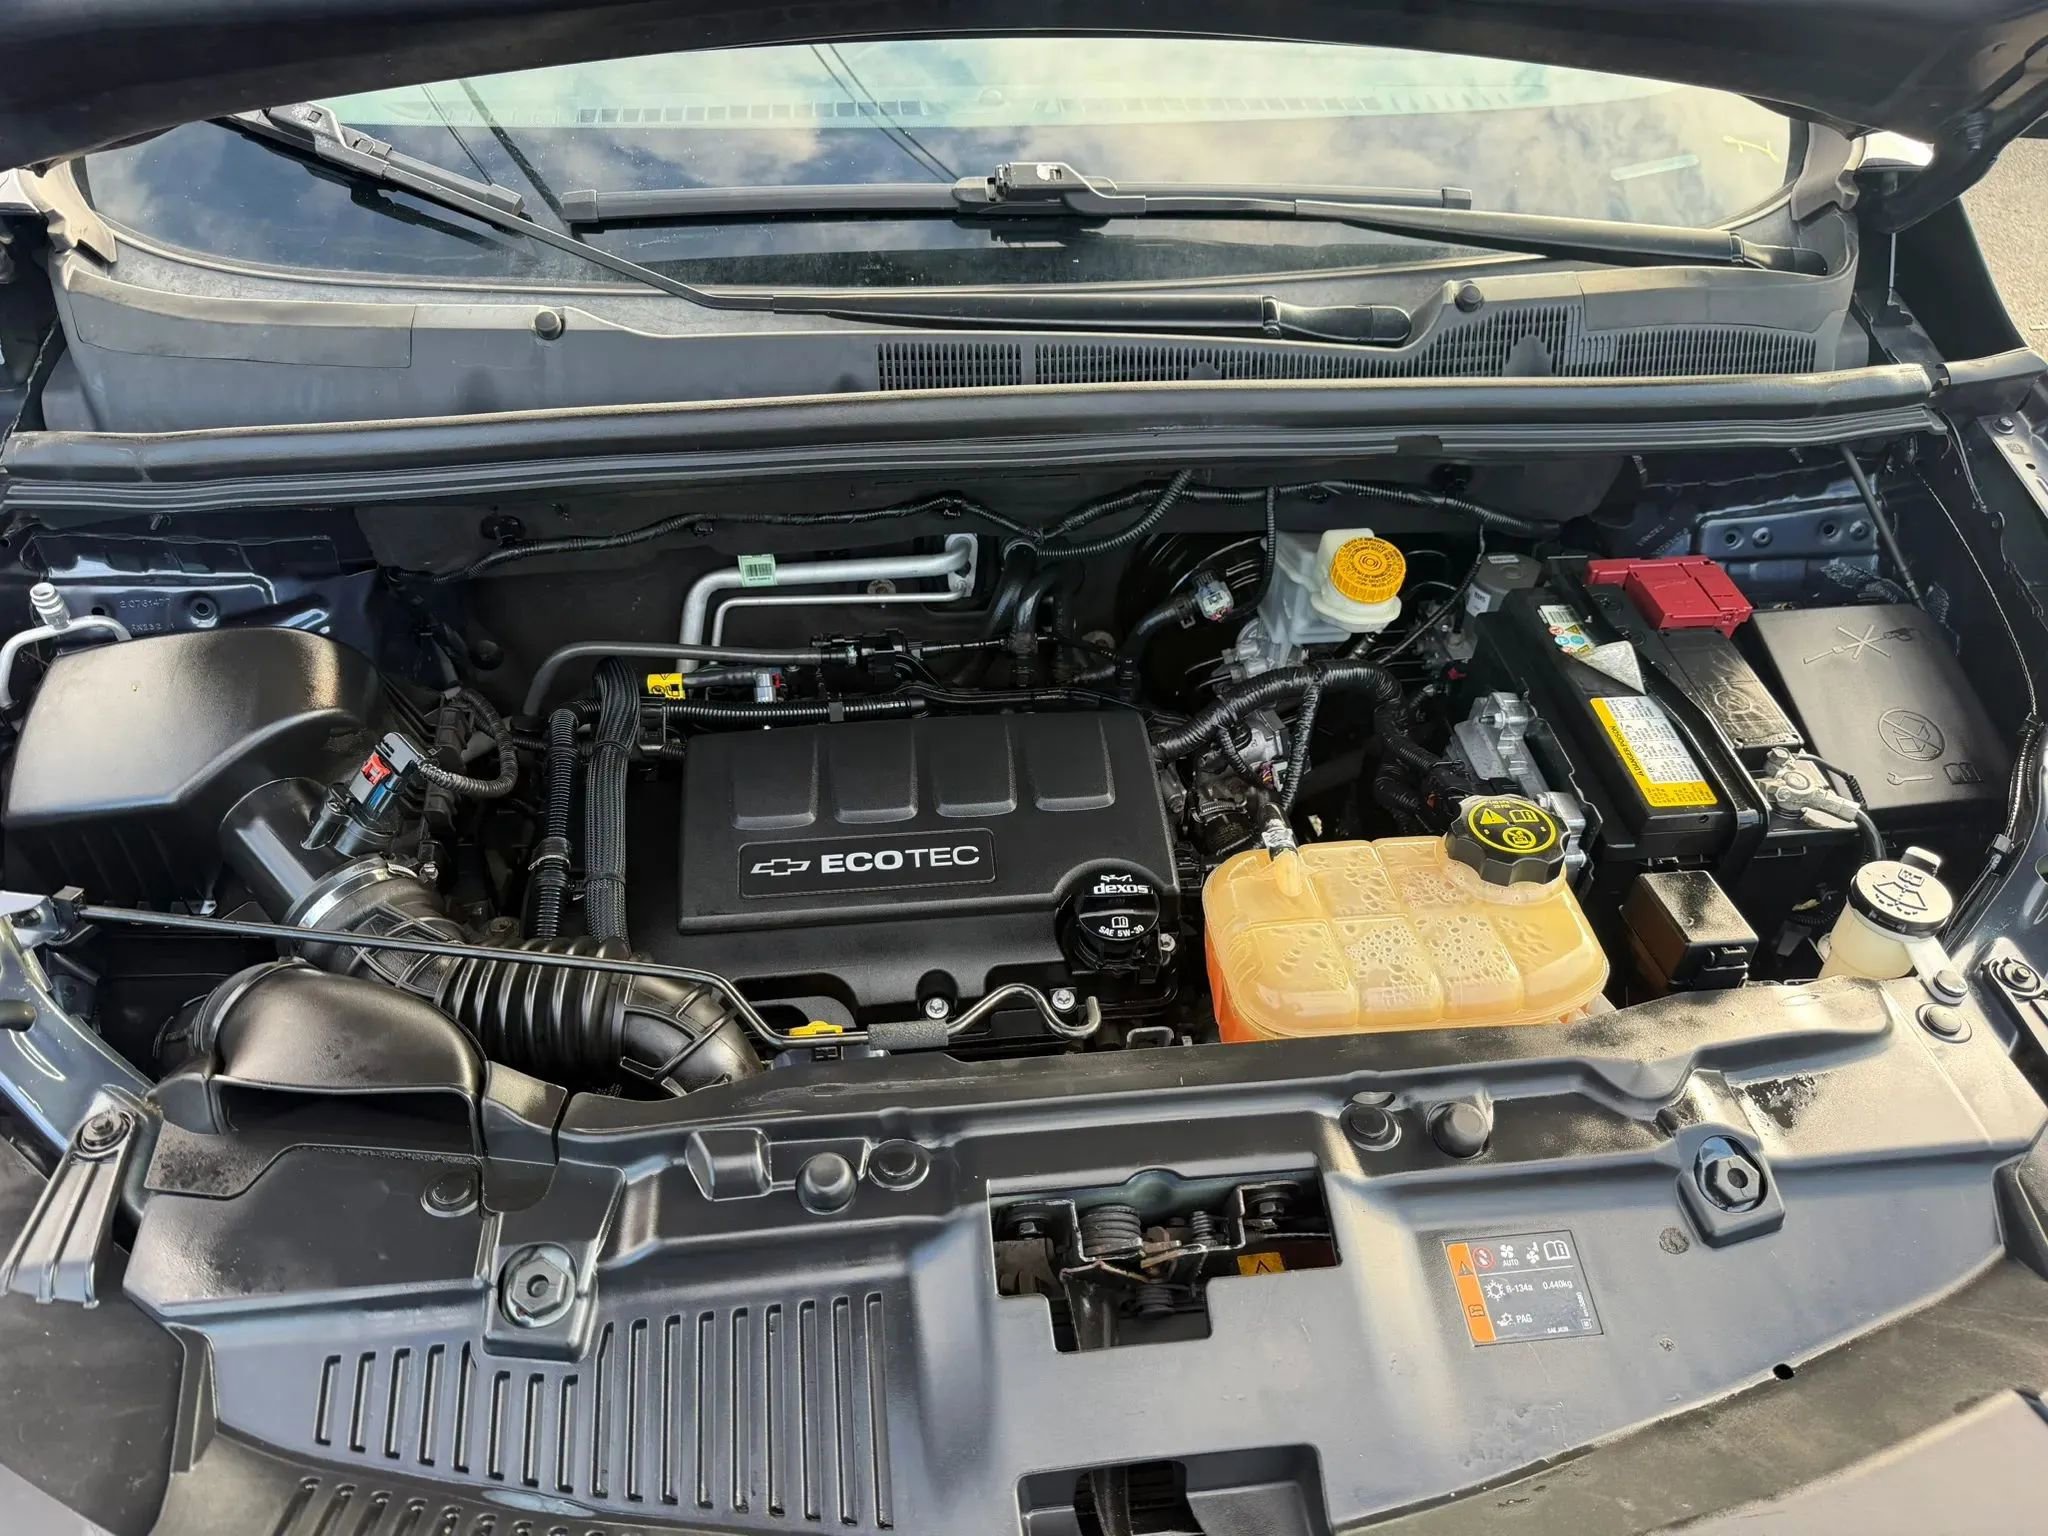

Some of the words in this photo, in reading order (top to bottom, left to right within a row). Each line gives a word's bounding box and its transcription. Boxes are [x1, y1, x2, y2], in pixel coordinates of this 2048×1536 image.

[821, 845, 980, 873] ECOTEC
[1093, 882, 1150, 895] dexos
[1098, 925, 1115, 937] SAE
[1117, 924, 1145, 937] 5W-30
[1503, 1259, 1519, 1267] AUTO
[1505, 1283, 1533, 1293] R-134a
[1515, 1313, 1533, 1324] PAG
